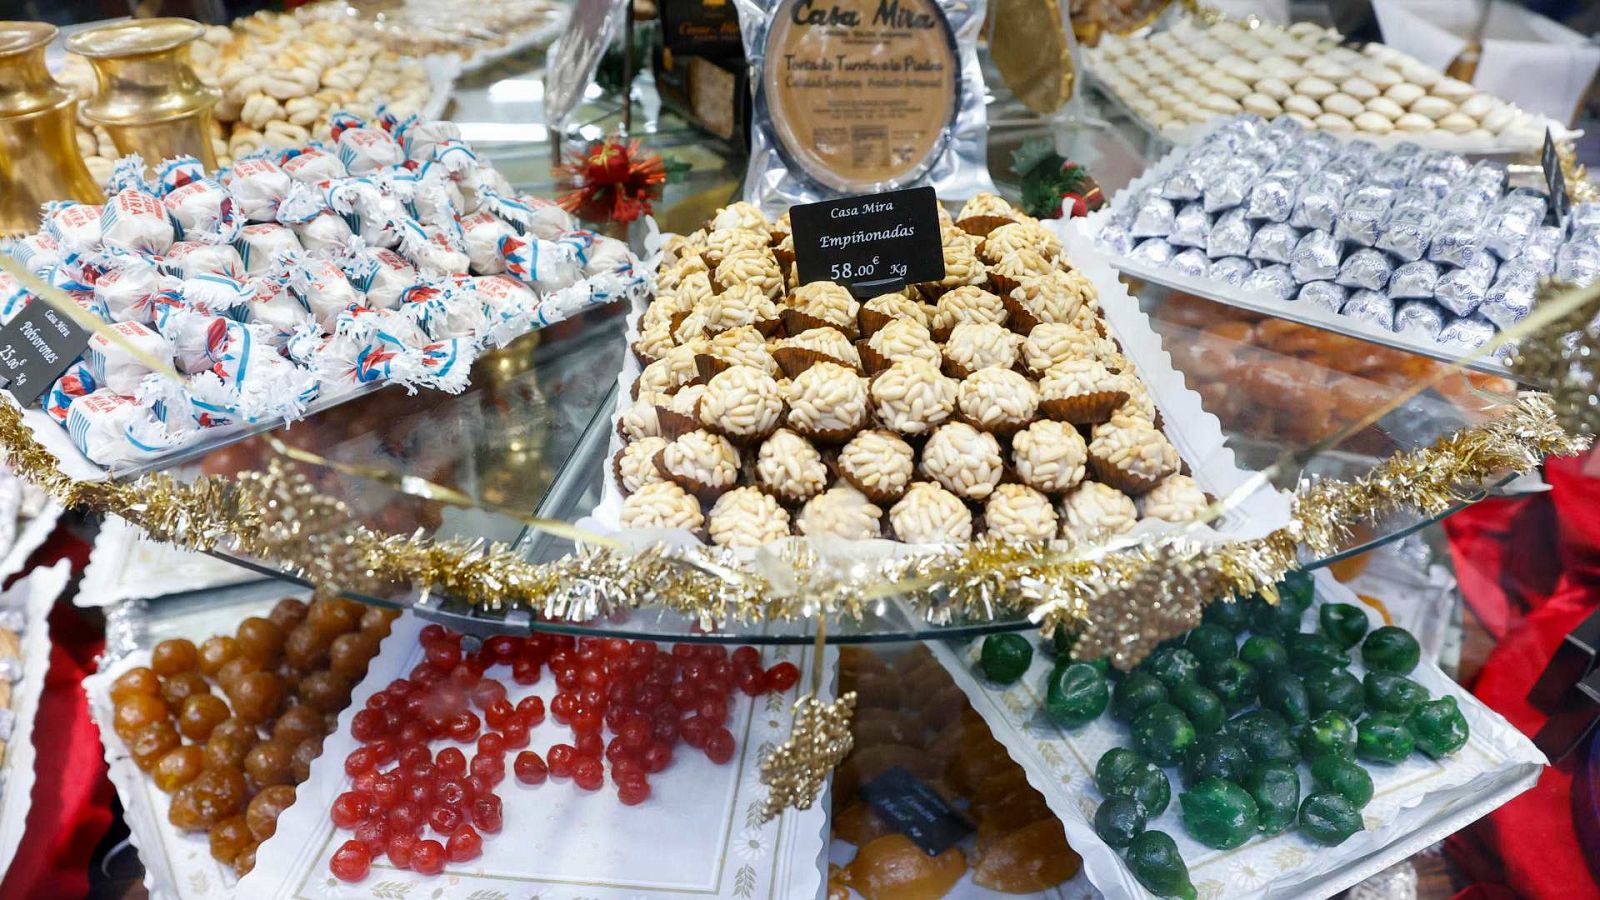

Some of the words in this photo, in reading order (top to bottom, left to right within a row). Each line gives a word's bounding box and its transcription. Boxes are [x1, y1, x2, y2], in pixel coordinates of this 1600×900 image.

[791, 0, 860, 27] Casa
[872, 0, 935, 29] Mira
[126, 189, 144, 215] MIRA
[830, 207, 859, 219] Casa
[862, 201, 894, 215] Mira
[819, 223, 915, 250] Empiñonadas
[889, 263, 908, 276] Kg
[44, 309, 59, 326] Casa
[55, 322, 70, 338] Mira
[19, 320, 59, 365] Polvorones
[15, 372, 28, 386] Kg
